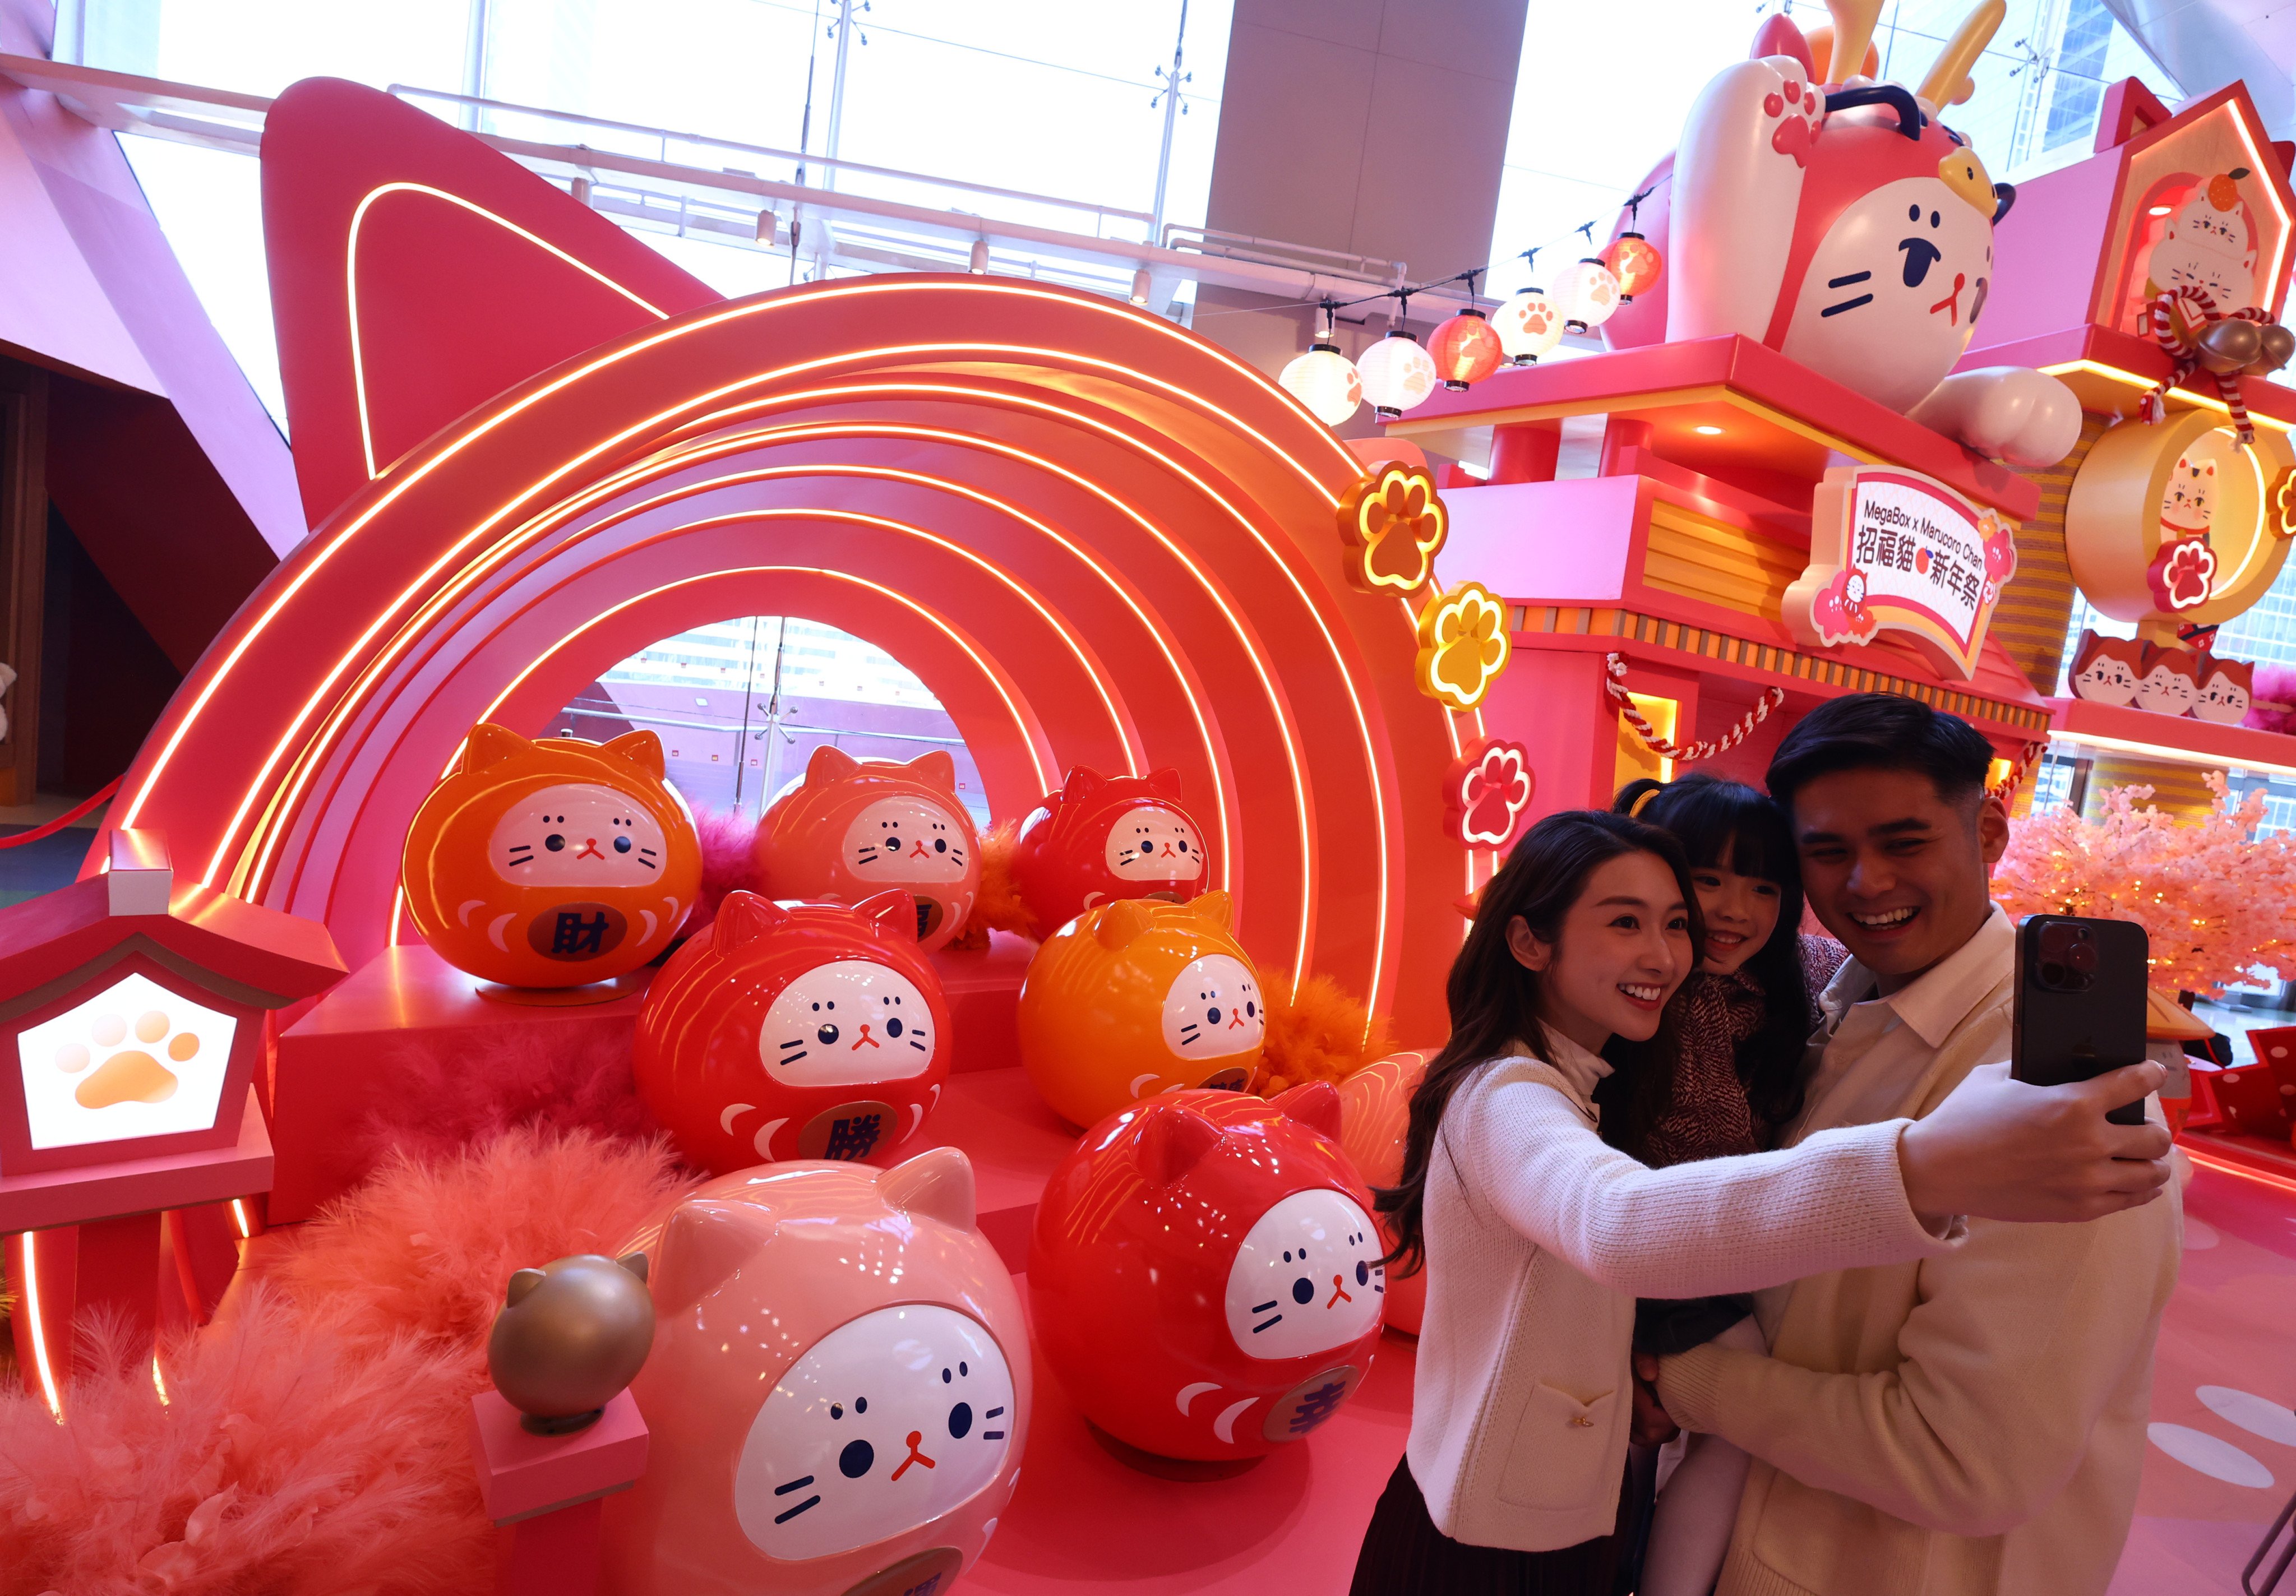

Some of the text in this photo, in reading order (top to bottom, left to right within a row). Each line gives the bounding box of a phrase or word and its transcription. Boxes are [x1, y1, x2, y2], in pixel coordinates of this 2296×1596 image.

[1864, 499, 1983, 571] MegaBox x Marucoro Chan
[1856, 525, 1980, 610] 招福貓 新年祭
[551, 912, 609, 954] 財
[824, 1114, 881, 1160] 勝
